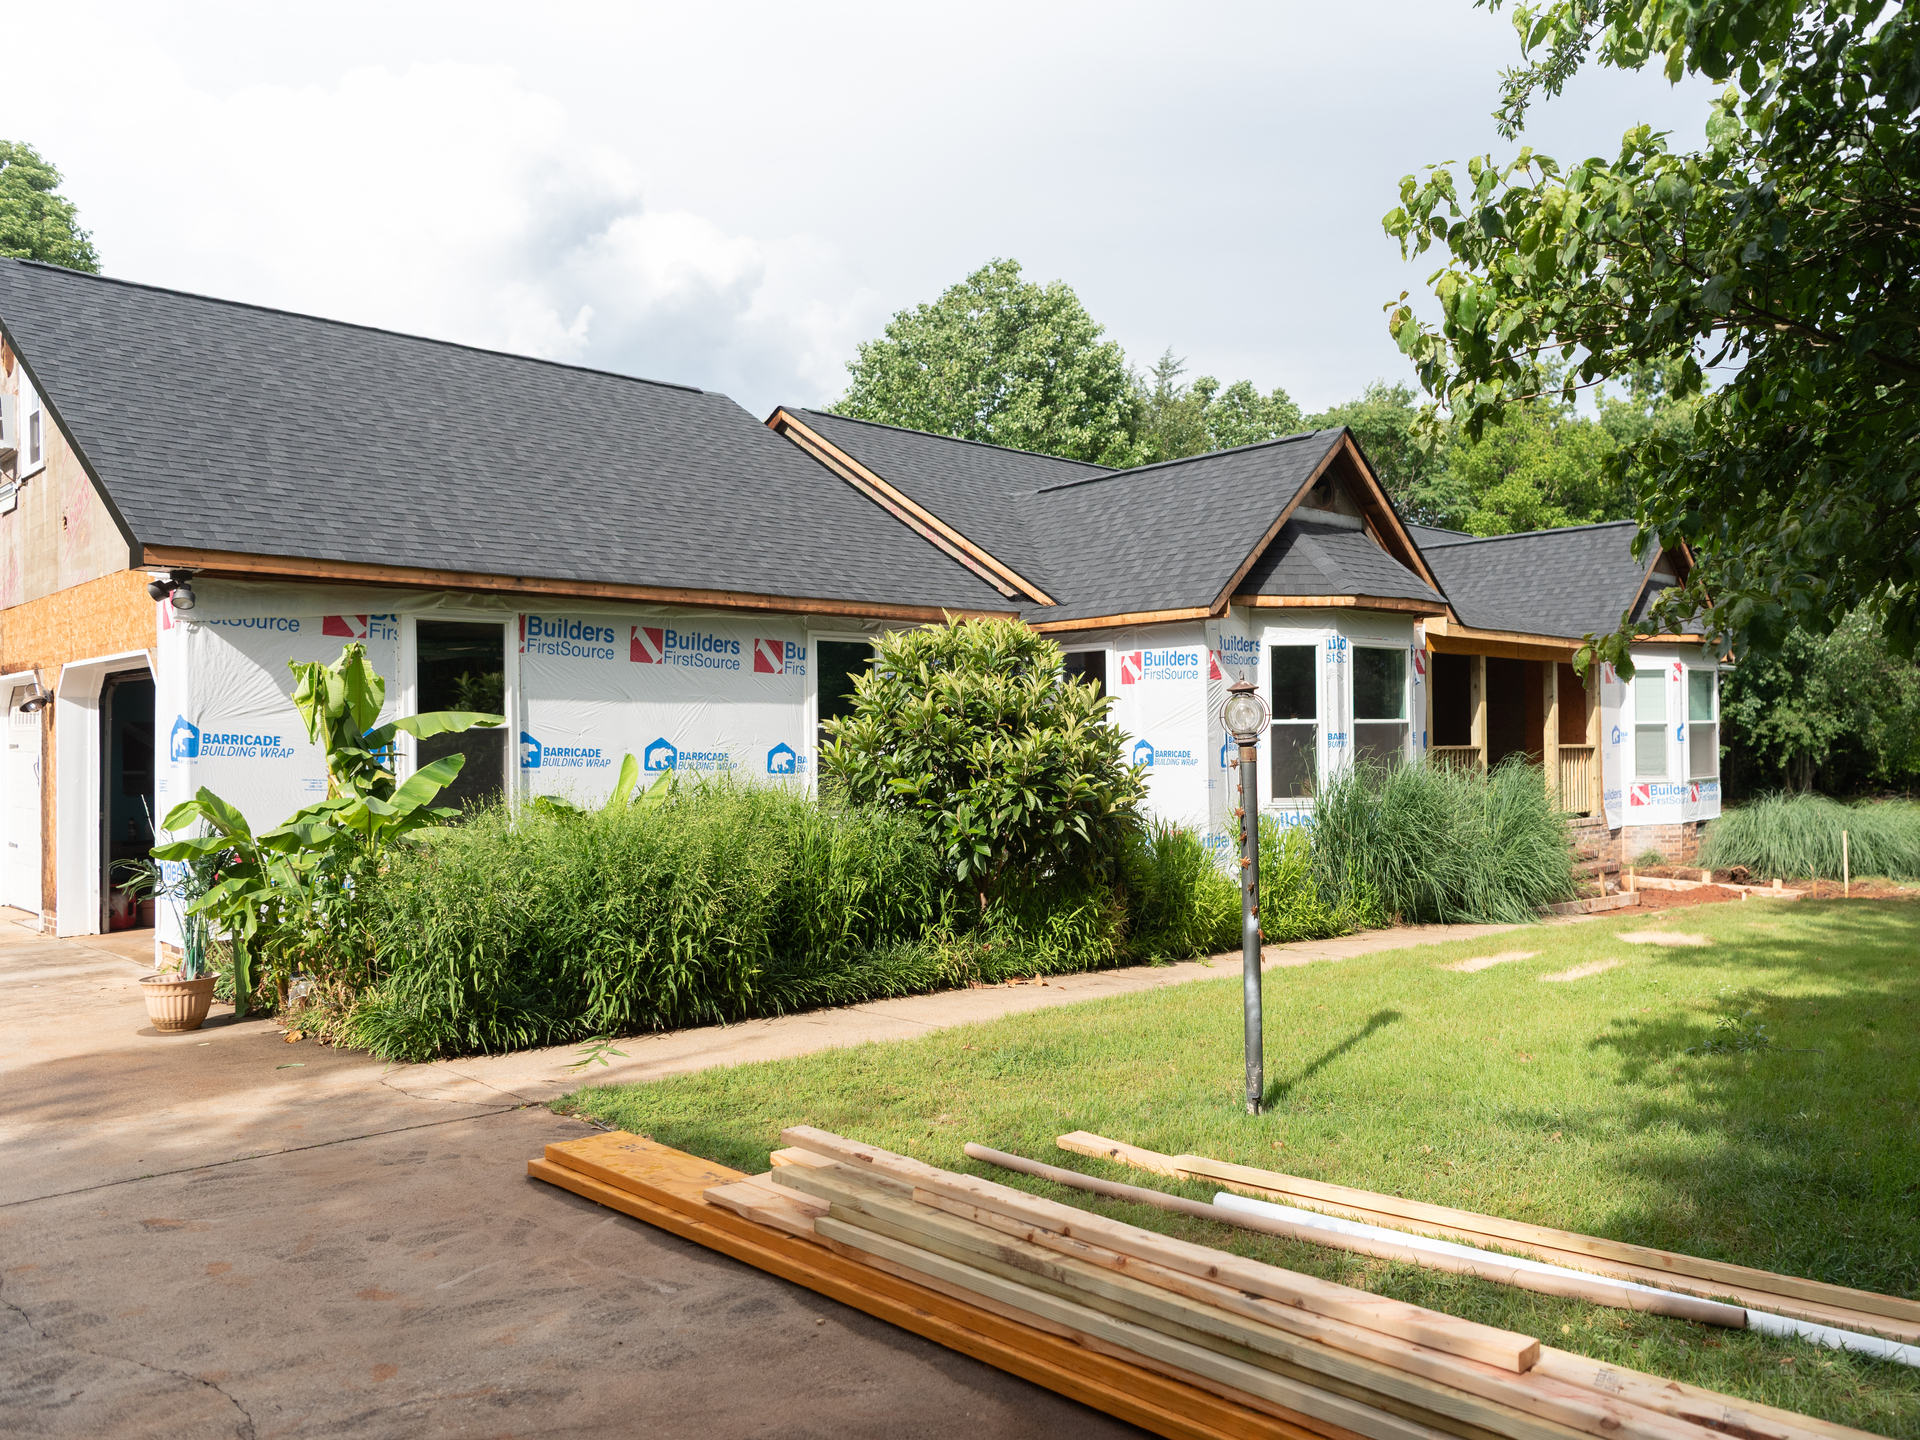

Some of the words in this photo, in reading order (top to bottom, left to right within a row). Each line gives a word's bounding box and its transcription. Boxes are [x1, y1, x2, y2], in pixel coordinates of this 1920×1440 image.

[527, 615, 615, 643] Builders
[664, 629, 740, 655] Builders
[526, 638, 615, 660] FirstSource
[785, 641, 806, 661] Bu
[664, 650, 740, 671] FirstSource
[1144, 650, 1198, 667] Builders
[1143, 667, 1198, 680] FirstSource
[202, 733, 281, 747] BARRICADE
[200, 745, 257, 757] BUILDING
[260, 747, 295, 758] WRAP
[543, 747, 601, 758] BARRICADE
[678, 751, 730, 762] BARRICADE
[1154, 750, 1191, 758] BARRICADE
[542, 757, 583, 767] BUILDING
[585, 758, 611, 768] WRAP
[677, 761, 715, 771] BUILDING
[1154, 758, 1180, 766] BUILDING
[1181, 758, 1199, 766] WRAP
